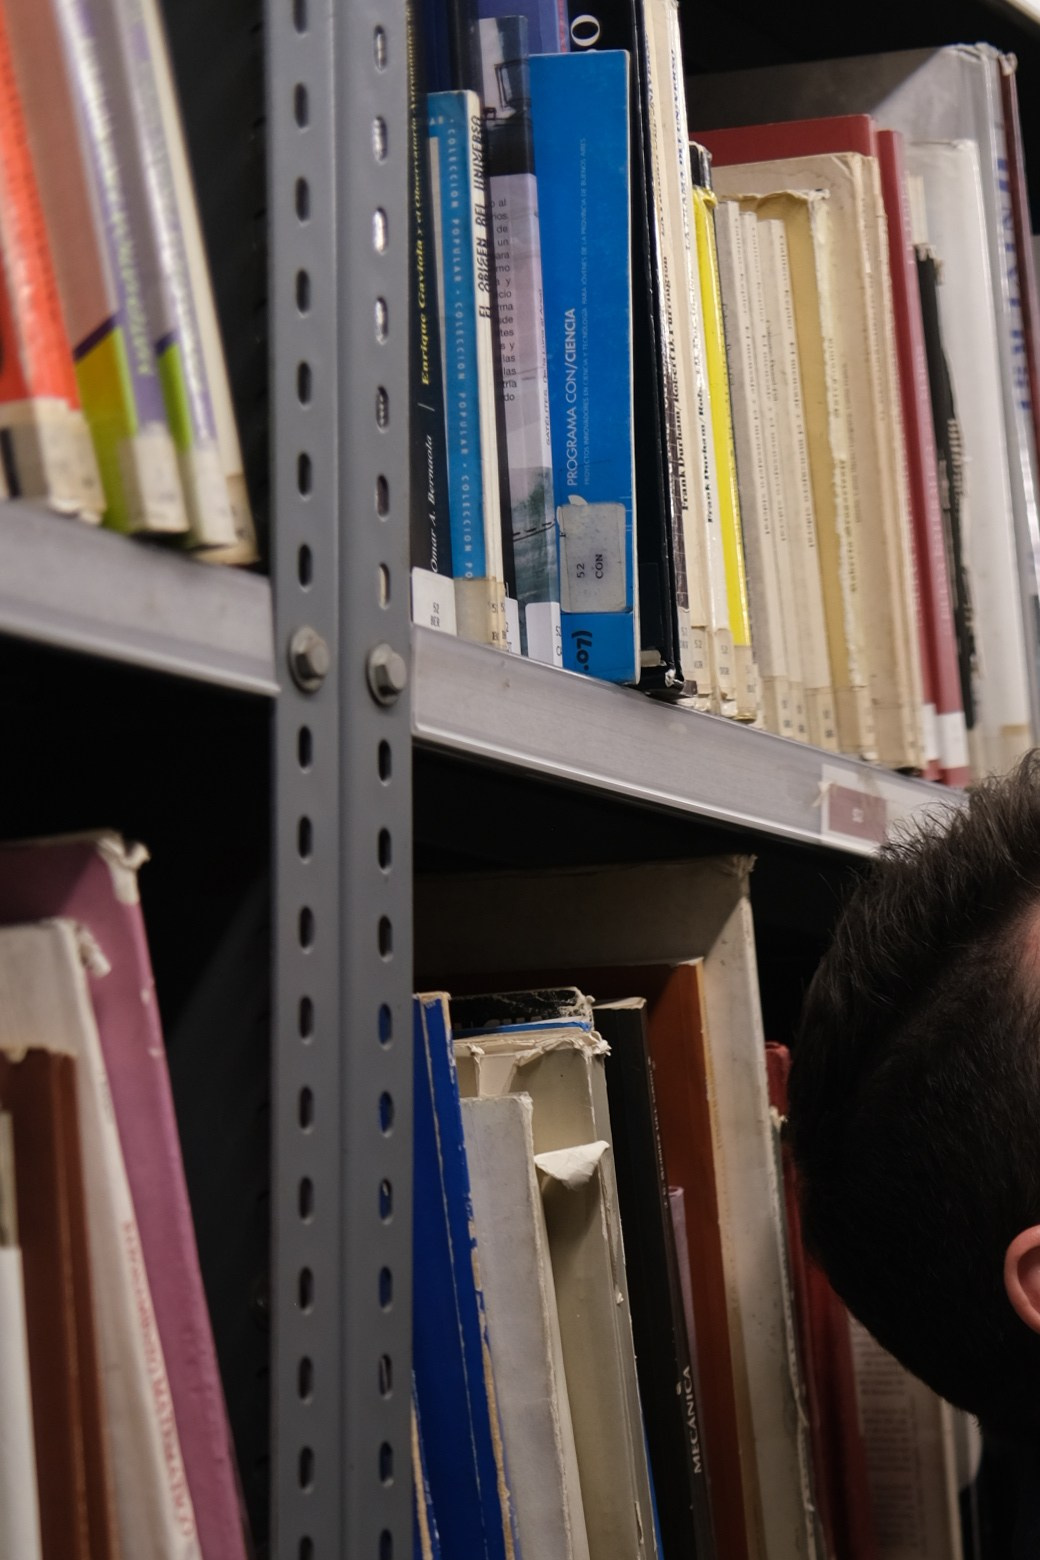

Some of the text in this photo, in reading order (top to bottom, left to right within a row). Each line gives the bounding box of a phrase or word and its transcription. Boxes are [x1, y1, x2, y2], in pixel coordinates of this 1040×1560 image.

[452, 218, 463, 283] POPULAR
[496, 225, 508, 234] de
[415, 240, 427, 309] Gaviola
[419, 313, 431, 385] Enrique
[454, 302, 466, 380] COLECCION
[458, 392, 470, 456] POPULAR
[564, 308, 578, 487] PROGRAMA CON/CIENCIA
[426, 434, 437, 505] Bernaola
[679, 470, 689, 511] Frank
[460, 475, 473, 553] COLECCION
[430, 527, 440, 573] Omar
[577, 563, 585, 578] 52
[595, 554, 604, 579] CON
